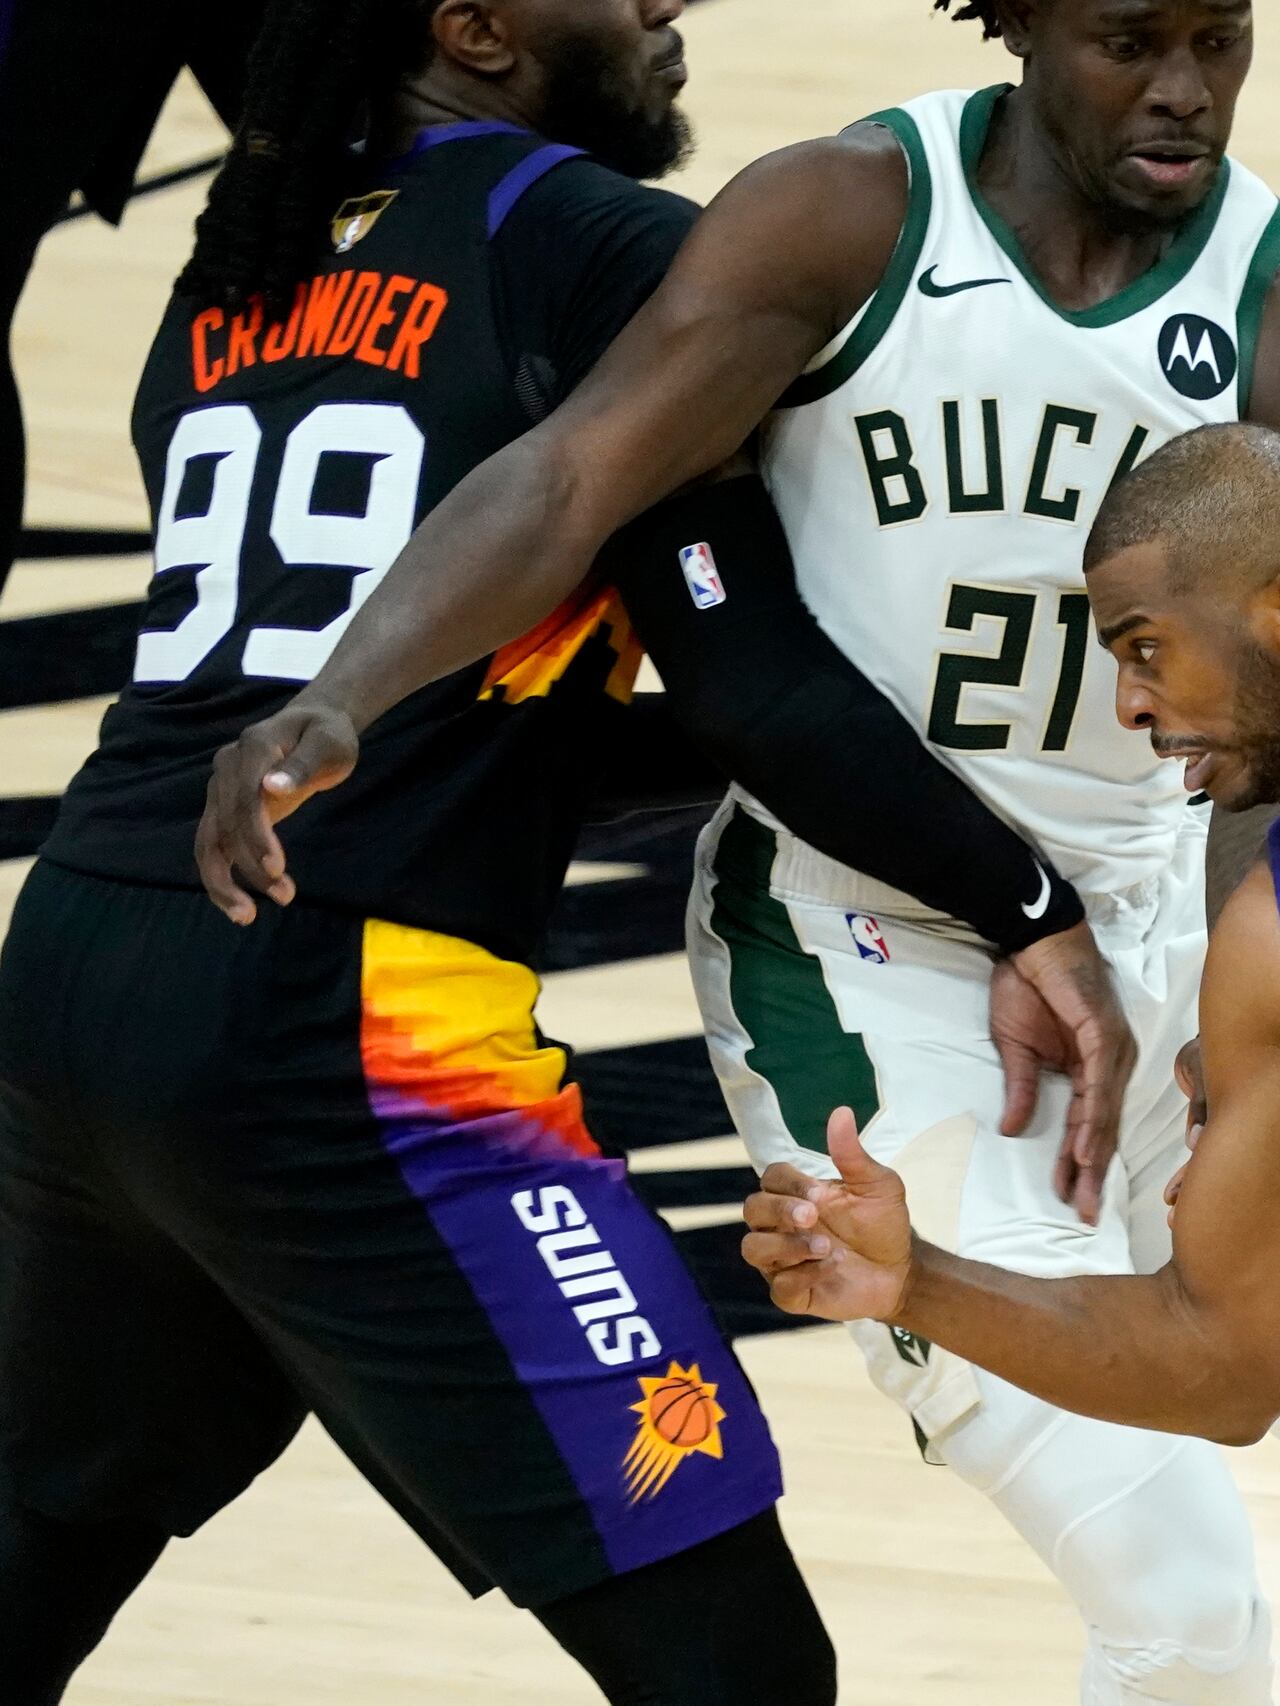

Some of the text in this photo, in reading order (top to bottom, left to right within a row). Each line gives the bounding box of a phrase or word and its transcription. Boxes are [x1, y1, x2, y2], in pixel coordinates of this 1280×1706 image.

[132, 402, 425, 682] 99
[926, 582, 1092, 753] 21
[510, 1184, 663, 1367] SUNS
